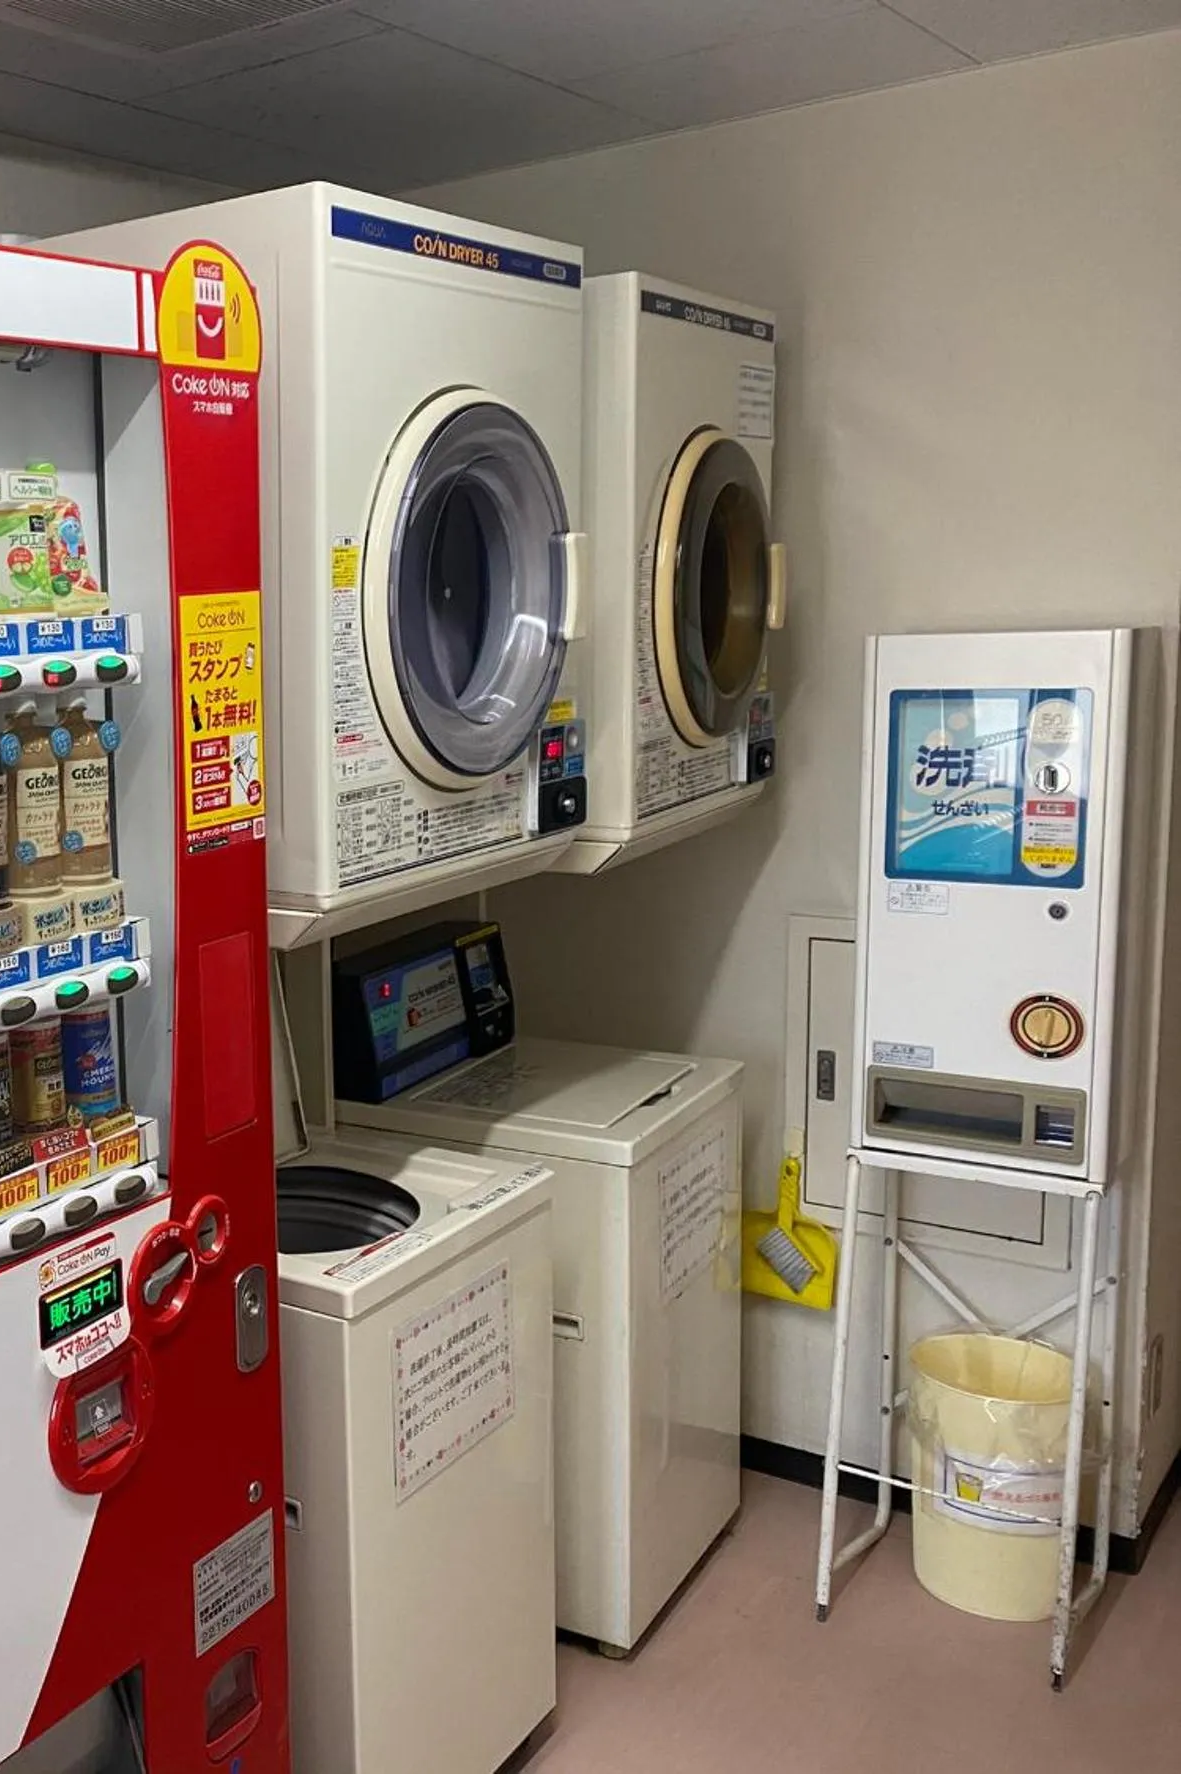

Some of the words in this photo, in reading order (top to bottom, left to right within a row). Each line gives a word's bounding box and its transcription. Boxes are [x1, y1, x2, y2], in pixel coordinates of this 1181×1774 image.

[448, 244, 483, 266] DRYER
[485, 251, 499, 269] 45
[172, 373, 208, 396] Coke
[209, 372, 230, 397] ON
[41, 623, 60, 633] ¥130
[197, 613, 227, 630] Coke
[189, 655, 243, 683] スタンプ
[205, 686, 238, 703] たまると
[205, 700, 257, 731] 1本無料!
[932, 799, 989, 817] せんざい
[102, 1145, 136, 1167] 100円
[52, 1164, 89, 1188] 100円
[57, 1259, 79, 1276] Coke
[95, 1245, 110, 1261] Pay
[49, 1280, 112, 1330] 販売中
